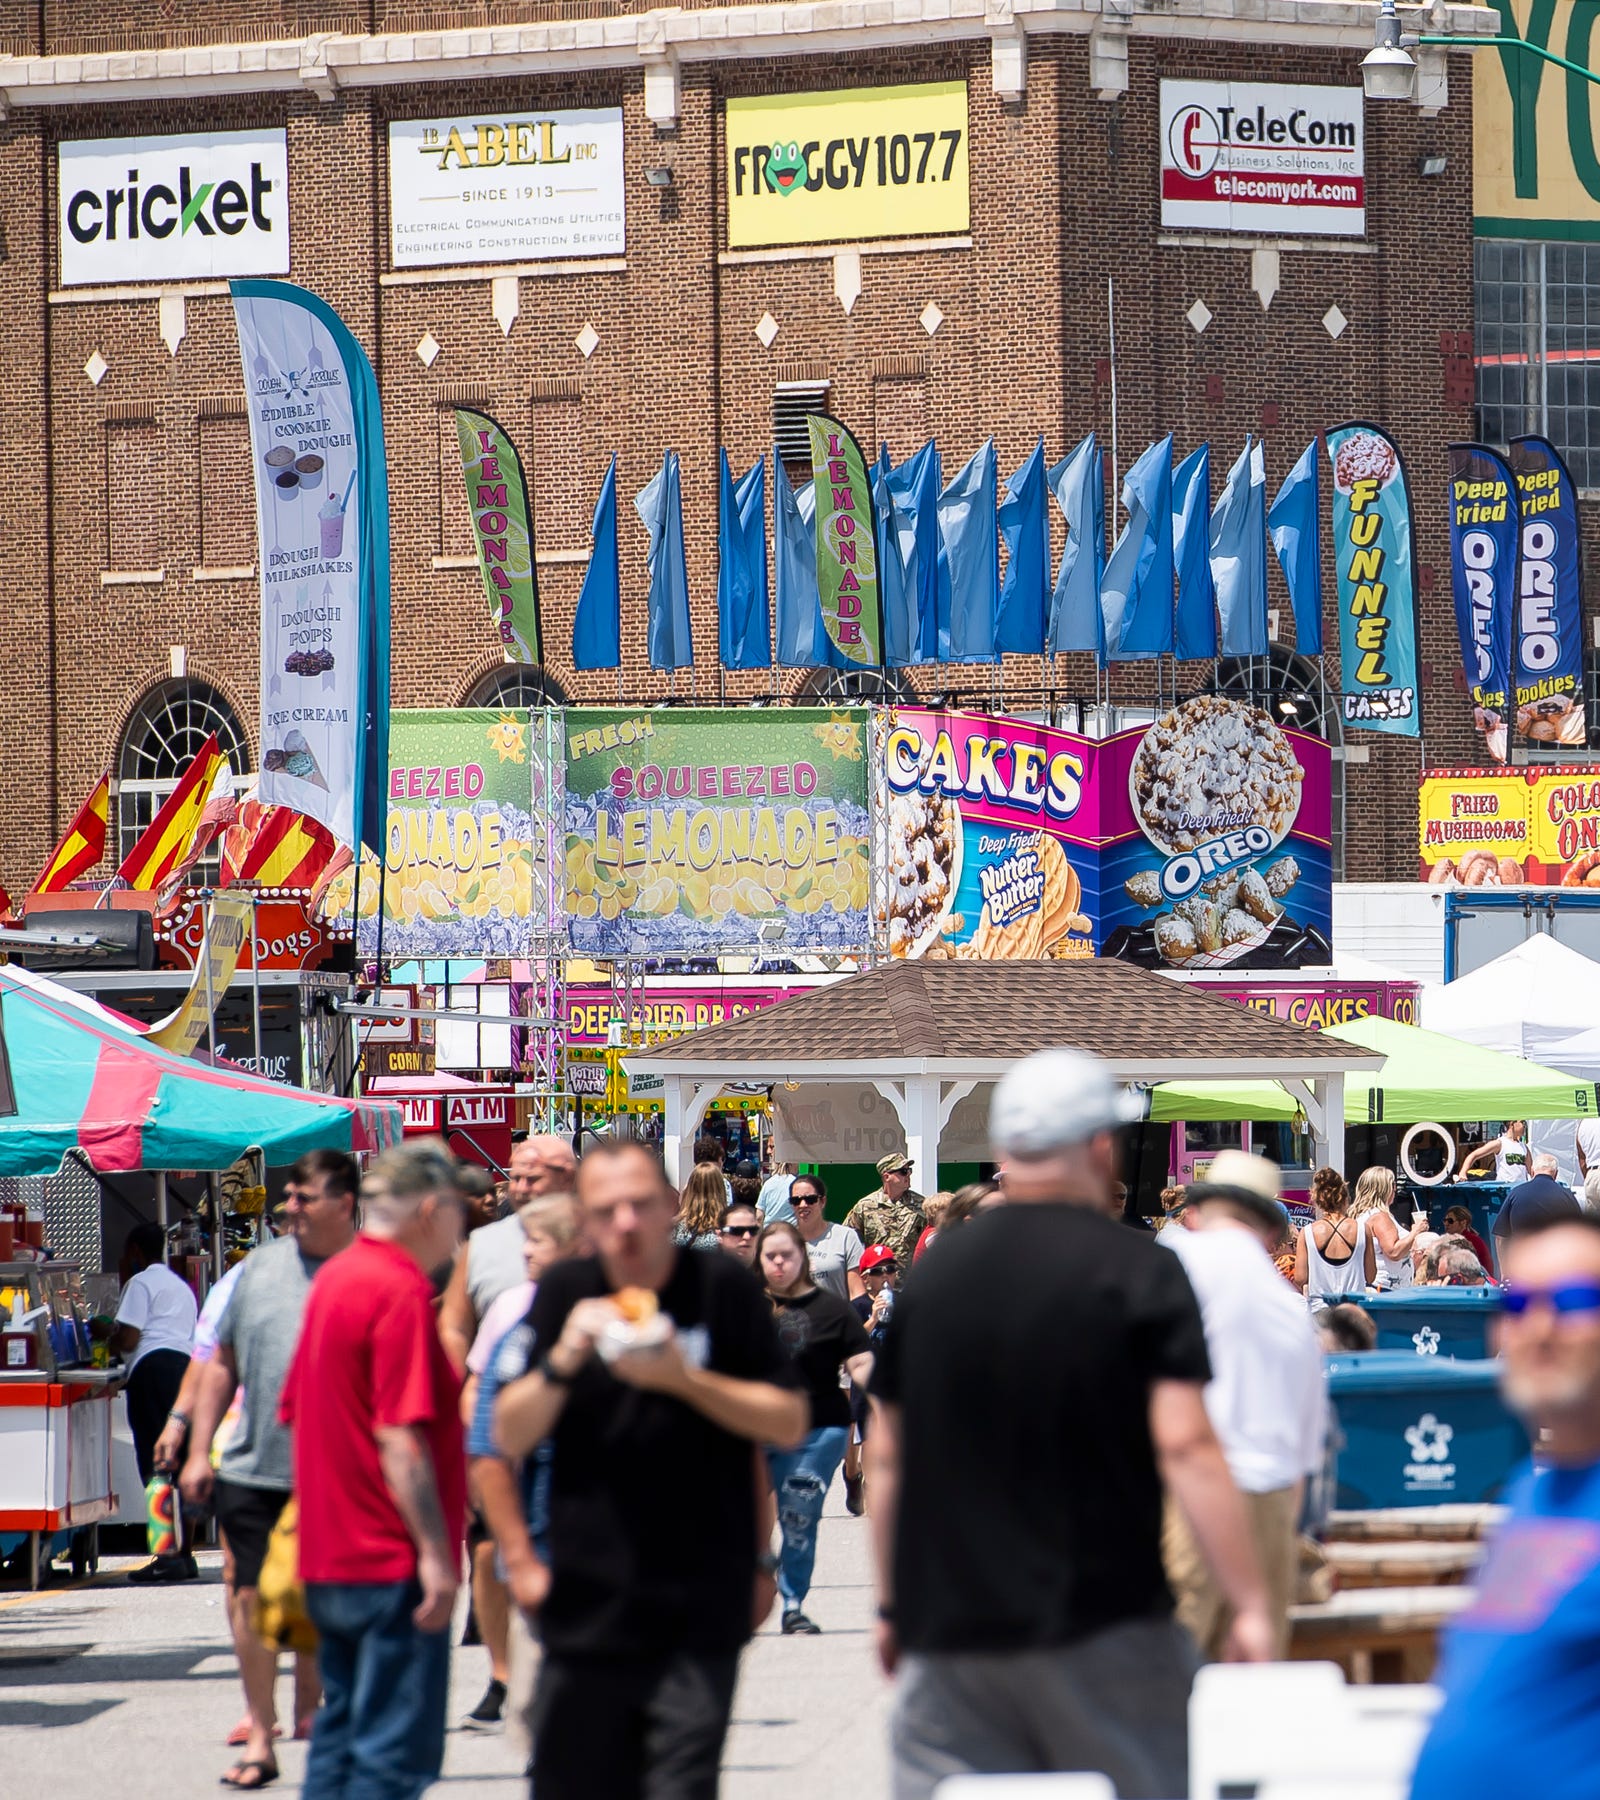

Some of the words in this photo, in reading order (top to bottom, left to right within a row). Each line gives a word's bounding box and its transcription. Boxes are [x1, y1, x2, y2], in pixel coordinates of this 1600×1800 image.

[1217, 106, 1355, 146] TeleCom
[422, 128, 439, 145] IB
[437, 119, 571, 170] ABEL
[734, 137, 869, 197] FRGGY
[1220, 153, 1271, 168] Business
[67, 162, 272, 244] cricket
[462, 188, 507, 203] SINCE
[515, 186, 554, 200] 1913
[1215, 176, 1357, 203] telecomyork.com
[261, 403, 315, 422] EDIBLE
[274, 418, 331, 438] COOKIE
[298, 433, 352, 452] DOUGH
[1454, 480, 1508, 501] Deep
[1522, 488, 1560, 516] ried
[476, 430, 516, 644] LEMONADE
[828, 434, 861, 645] LEMONADE
[269, 546, 319, 566] DOUGH
[264, 561, 353, 584] MILKSHAKES
[1349, 479, 1389, 684] FUNNEL
[1521, 523, 1558, 671] OREO
[281, 607, 341, 627] DOUGH
[289, 627, 332, 646] POPS
[268, 709, 289, 726] ICE
[292, 708, 348, 722] CREAM
[570, 715, 654, 762] FRESH
[390, 763, 485, 799] EEZED
[610, 762, 818, 799] SQUEEZED
[886, 727, 1083, 819] CAKES
[1451, 794, 1499, 816] FRIED
[1178, 811, 1211, 832] Deep
[1214, 808, 1254, 826] Fried!
[1425, 820, 1527, 844] MUSHROOMS
[370, 808, 502, 873] ONADE
[596, 808, 838, 872] LEMONADE
[979, 836, 1007, 856] Deep
[1008, 830, 1043, 850] Fried!
[1163, 828, 1270, 895] OREO
[980, 854, 1037, 899] Nutter
[988, 875, 1044, 923] Butter
[1066, 939, 1095, 951] REAL
[1289, 997, 1370, 1030] CAKES
[397, 1100, 428, 1122] TM
[450, 1097, 504, 1121] ATM
